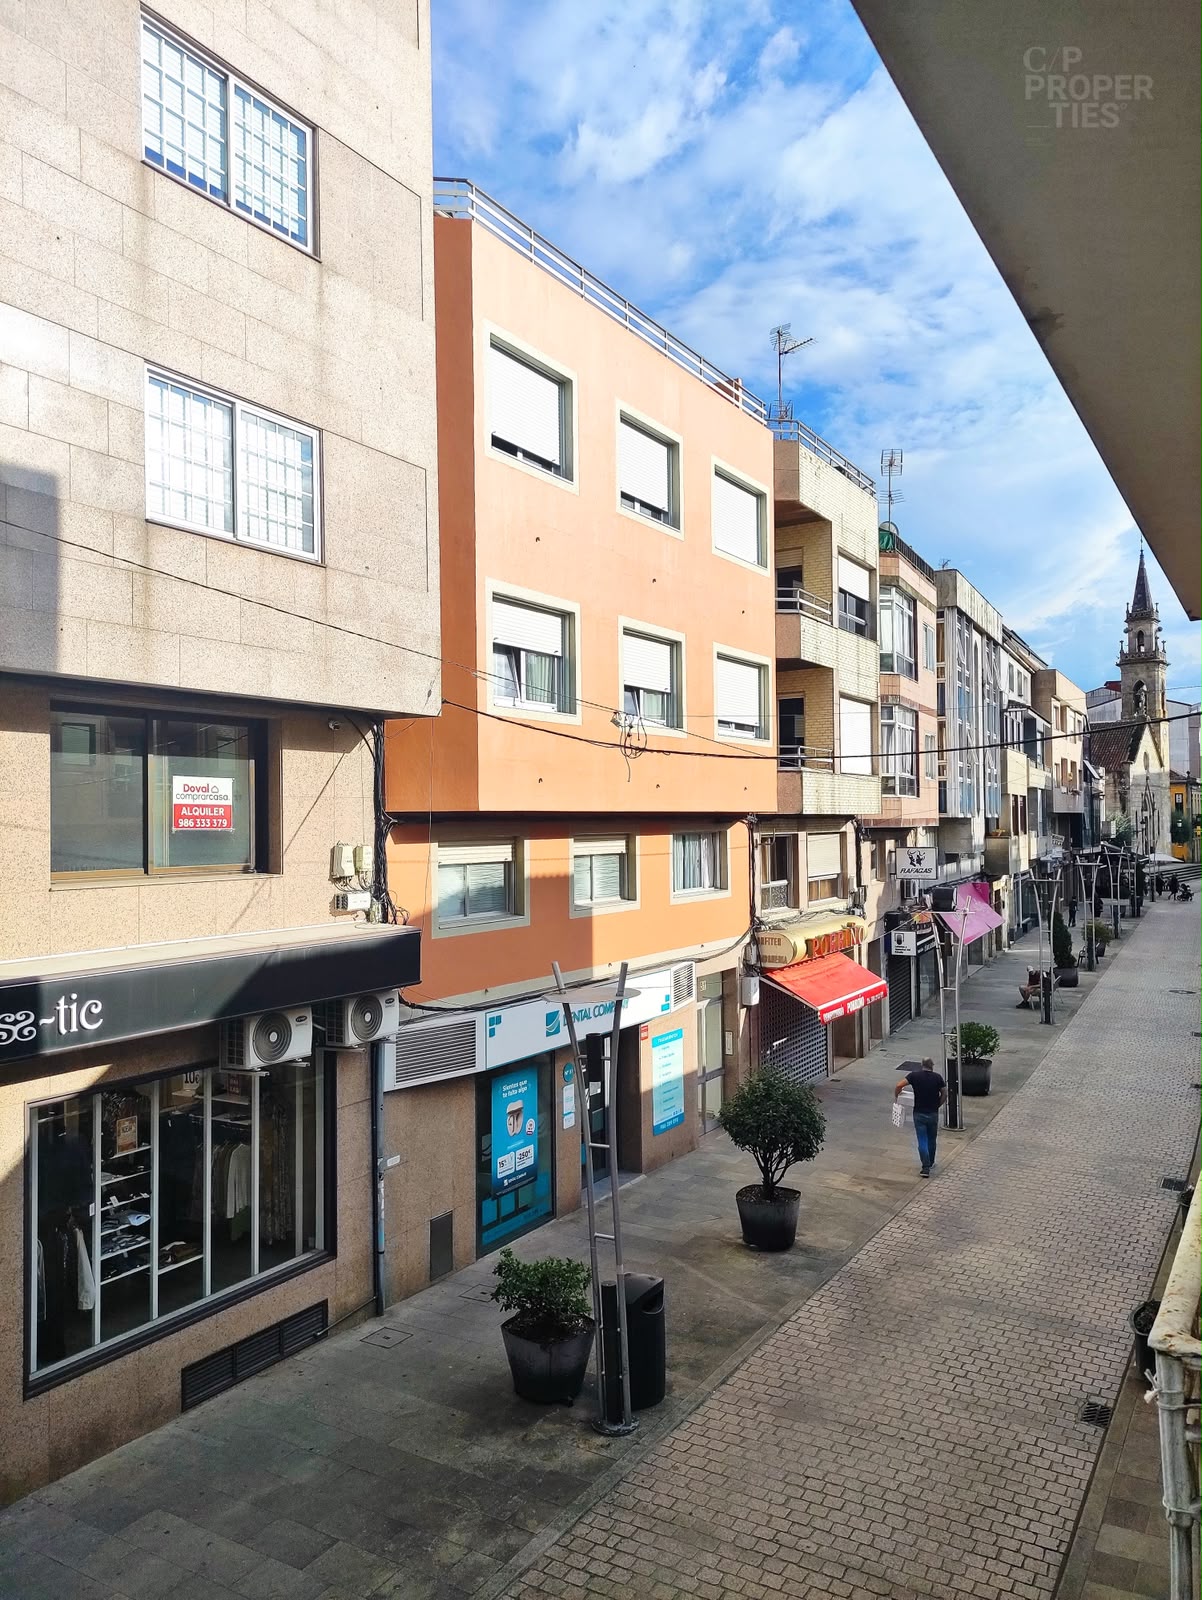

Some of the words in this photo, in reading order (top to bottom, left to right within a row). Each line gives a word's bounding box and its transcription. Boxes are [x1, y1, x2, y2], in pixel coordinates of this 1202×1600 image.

[183, 783, 210, 793] Doval
[181, 806, 225, 816] ALQUILER
[178, 818, 194, 828] 986
[195, 818, 210, 828] 333
[212, 818, 228, 828] 379
